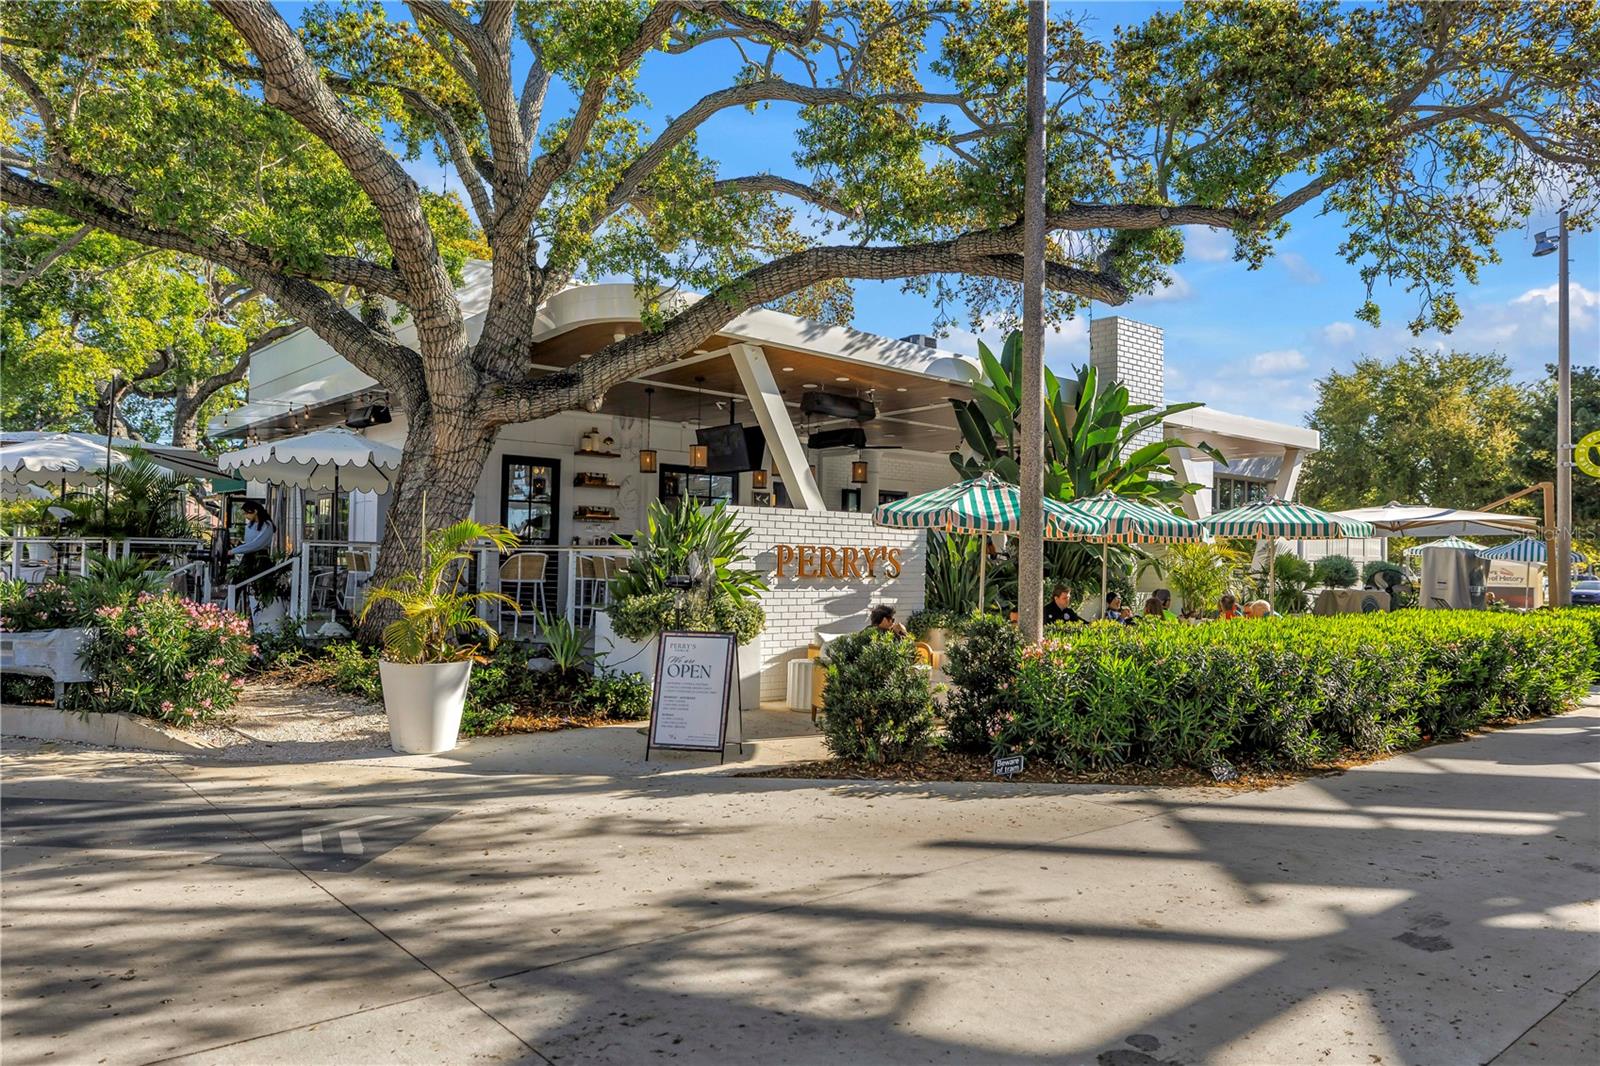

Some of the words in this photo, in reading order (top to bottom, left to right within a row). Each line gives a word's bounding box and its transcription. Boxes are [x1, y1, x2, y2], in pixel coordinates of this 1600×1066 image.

[776, 544, 901, 579] PERRY'S
[1500, 575, 1524, 583] History
[667, 664, 712, 678] OPEN
[997, 758, 1020, 767] Beware
